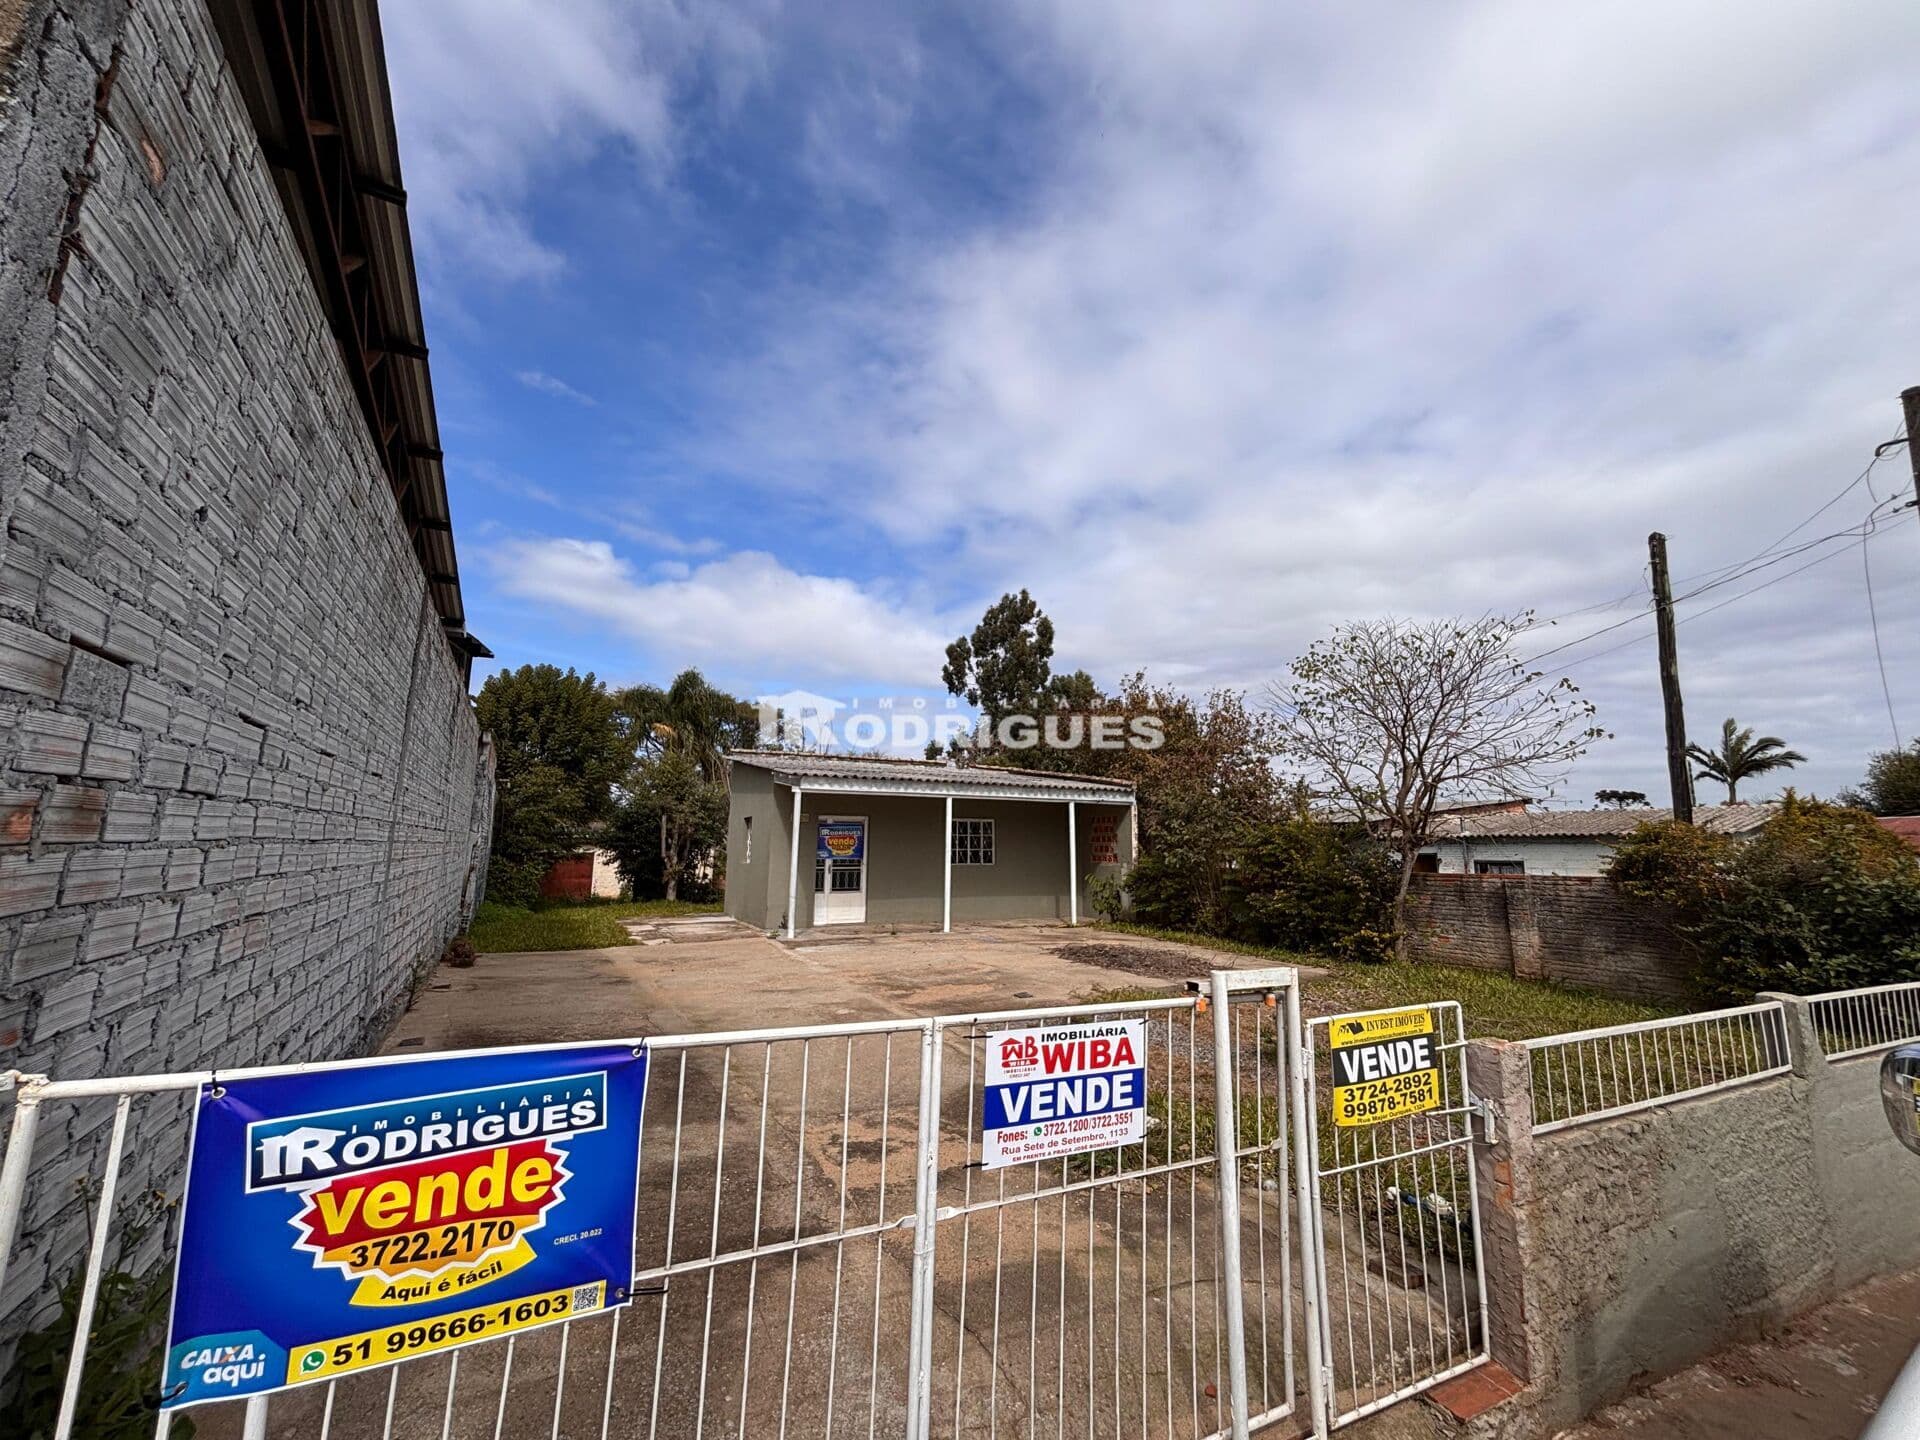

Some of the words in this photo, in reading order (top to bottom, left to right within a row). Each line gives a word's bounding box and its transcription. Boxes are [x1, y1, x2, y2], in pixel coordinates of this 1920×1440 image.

[828, 837, 855, 846] vende
[1041, 1027, 1128, 1043] IMOBILIÁRIA
[1366, 1017, 1394, 1032] INVEST
[1395, 1013, 1425, 1028] IMÓVEIS
[1041, 1037, 1137, 1075] WIBA
[1340, 1037, 1431, 1083] VENDE
[1000, 1073, 1133, 1124] VENDE
[1343, 1072, 1432, 1103] 3724-2892
[1343, 1087, 1434, 1118] 99878-7581
[256, 1100, 597, 1179] RODRIGUES
[997, 1130, 1028, 1145] Fones:
[1043, 1111, 1133, 1137] 3722.1200/3722.3551
[1001, 1146, 1021, 1156] Rua
[1023, 1142, 1045, 1152] Sete
[1047, 1139, 1059, 1148] de
[1061, 1132, 1107, 1146] Setembro,
[1110, 1127, 1129, 1138] 1133
[1023, 1152, 1046, 1160] FRENTE
[316, 1148, 553, 1236] vende
[350, 1220, 515, 1268] 3722.2170
[381, 1282, 431, 1302] Aqui
[437, 1278, 451, 1293] é
[457, 1260, 504, 1289] fácil
[332, 1337, 372, 1367] 51
[386, 1294, 569, 1354] 99666-1603
[180, 1343, 254, 1370] CAIXA
[203, 1353, 266, 1388] aqui
